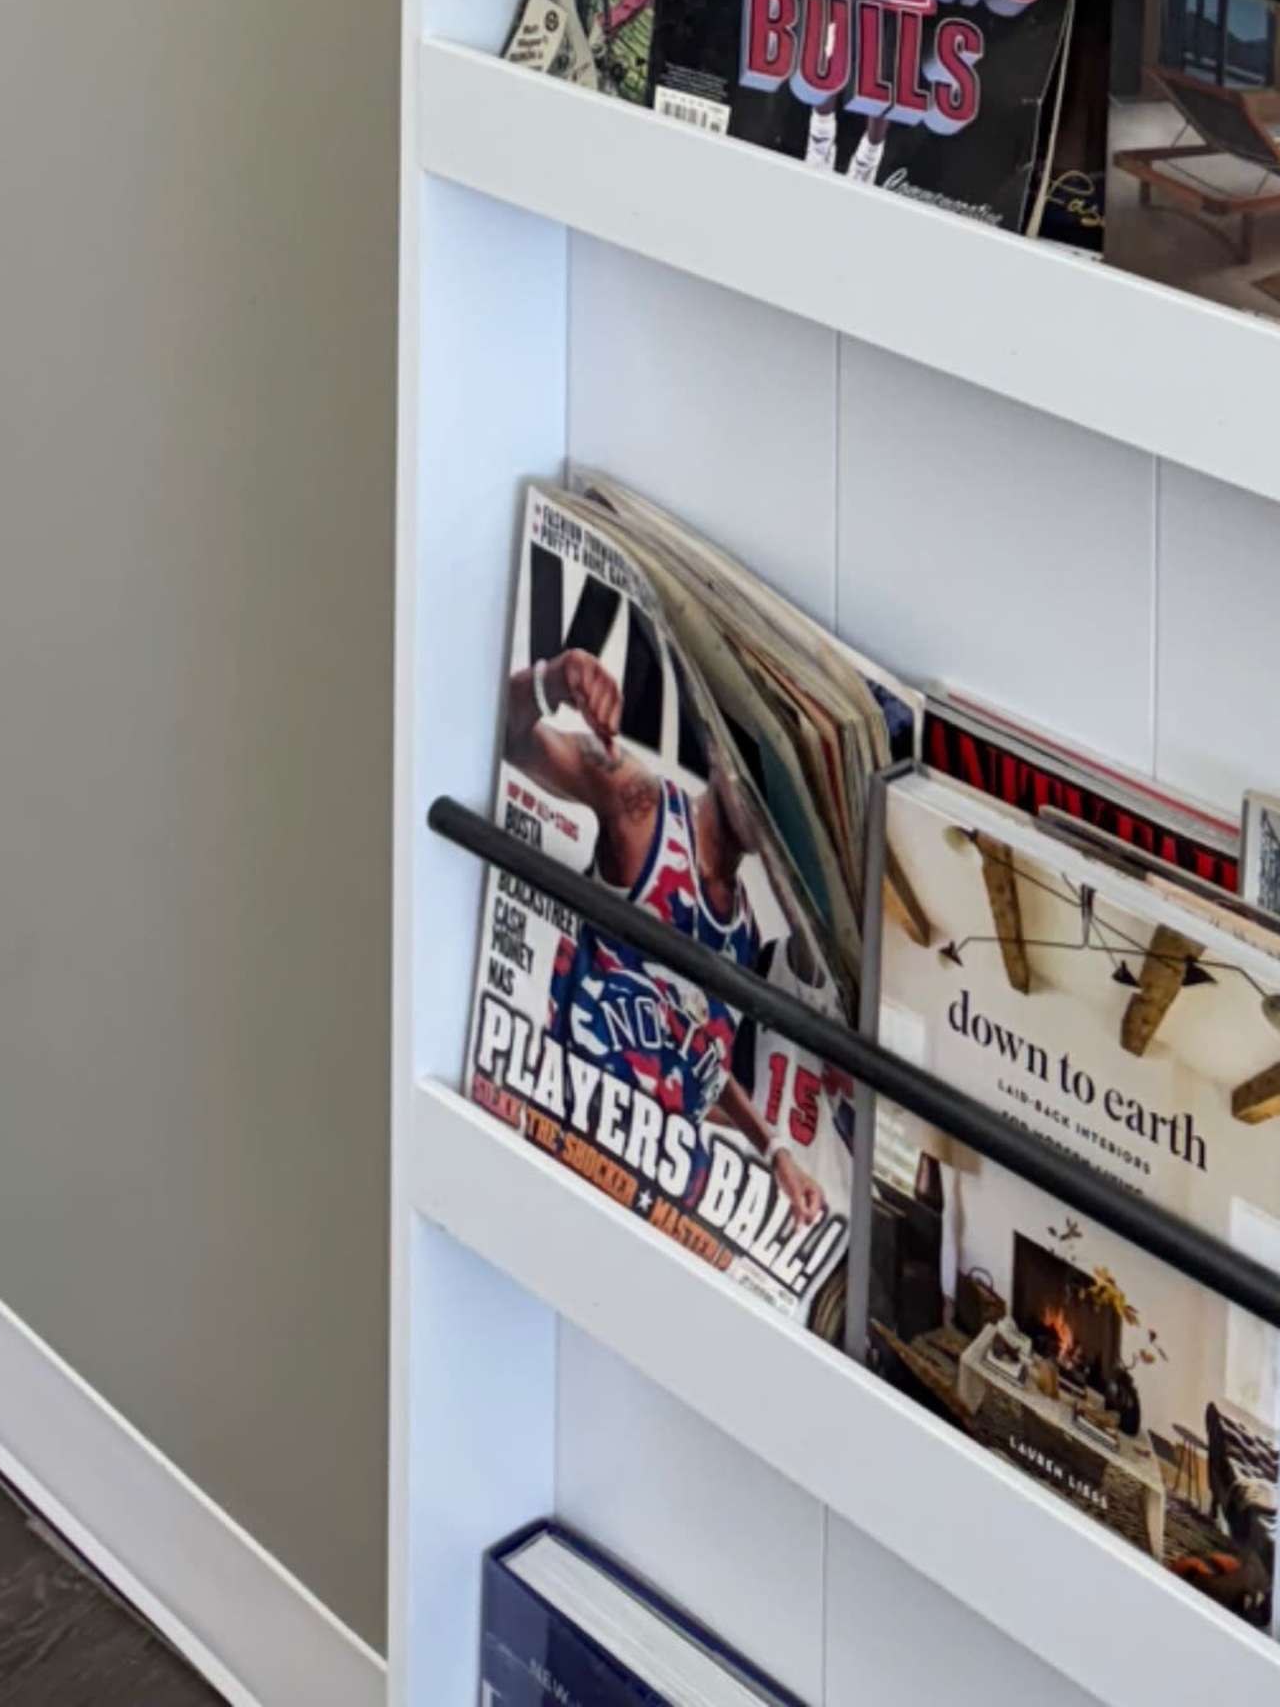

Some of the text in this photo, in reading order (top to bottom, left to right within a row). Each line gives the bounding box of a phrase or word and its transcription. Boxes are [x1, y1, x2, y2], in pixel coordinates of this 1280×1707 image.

[492, 927, 535, 975] MONEY
[493, 896, 527, 931] CASH
[487, 954, 516, 996] NAS
[765, 1051, 820, 1147] 15
[949, 989, 1208, 1173] down to earth
[998, 1077, 1151, 1176] LAID-BACK INTERIORS
[475, 998, 844, 1292] PLAYERS BALL!
[527, 1106, 562, 1151] THE
[562, 1130, 638, 1207] SHOCKER
[649, 1195, 720, 1265] MASTER
